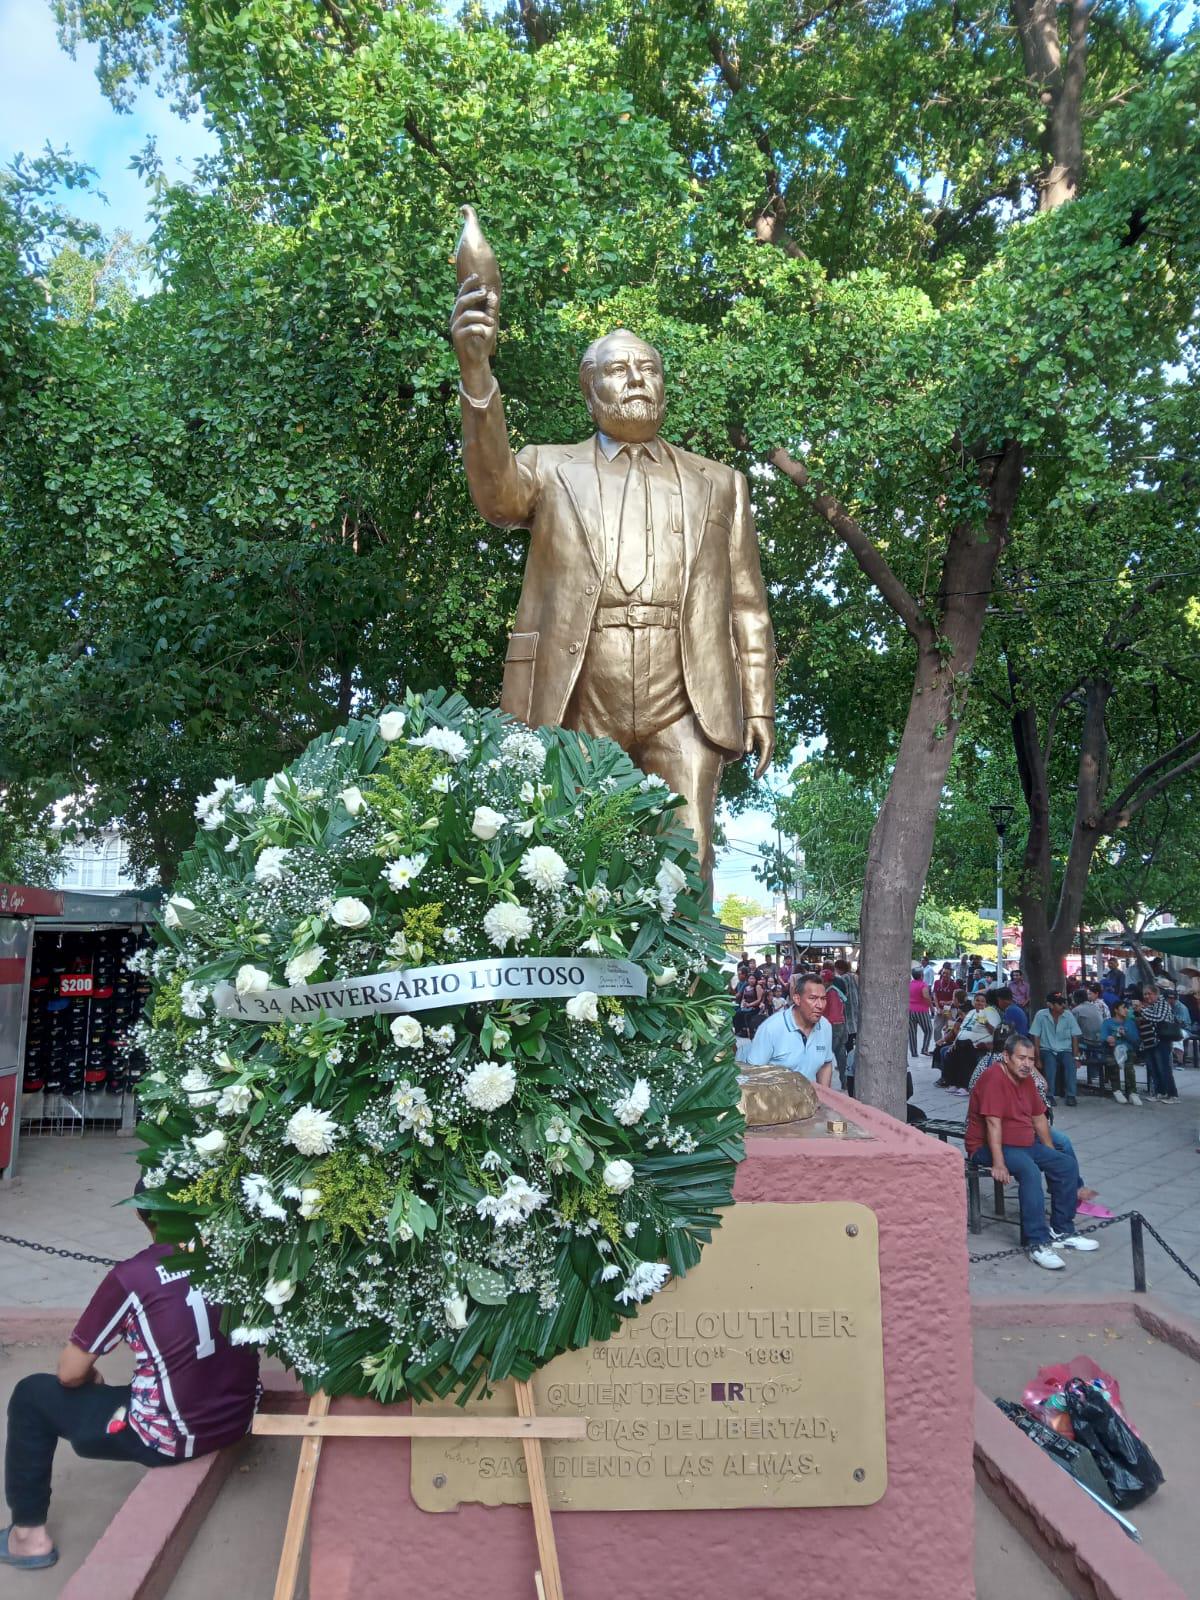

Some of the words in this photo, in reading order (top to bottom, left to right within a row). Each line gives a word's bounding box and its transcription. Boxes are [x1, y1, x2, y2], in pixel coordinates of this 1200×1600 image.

[61, 978, 92, 992] $200
[254, 999, 282, 1014] 34
[290, 974, 461, 1014] ANIVERSARIO
[469, 966, 585, 989] LUCTOSO
[651, 1311, 857, 1339] CLOUTHIER
[746, 1349, 793, 1365] 1989
[548, 1383, 633, 1406] QUIEN
[641, 1382, 779, 1405] DESPRTO
[657, 1417, 698, 1441] DE
[478, 1455, 655, 1478] SACDIENDO
[664, 1454, 713, 1477] LAS
[722, 1453, 822, 1477] ALMAS.
